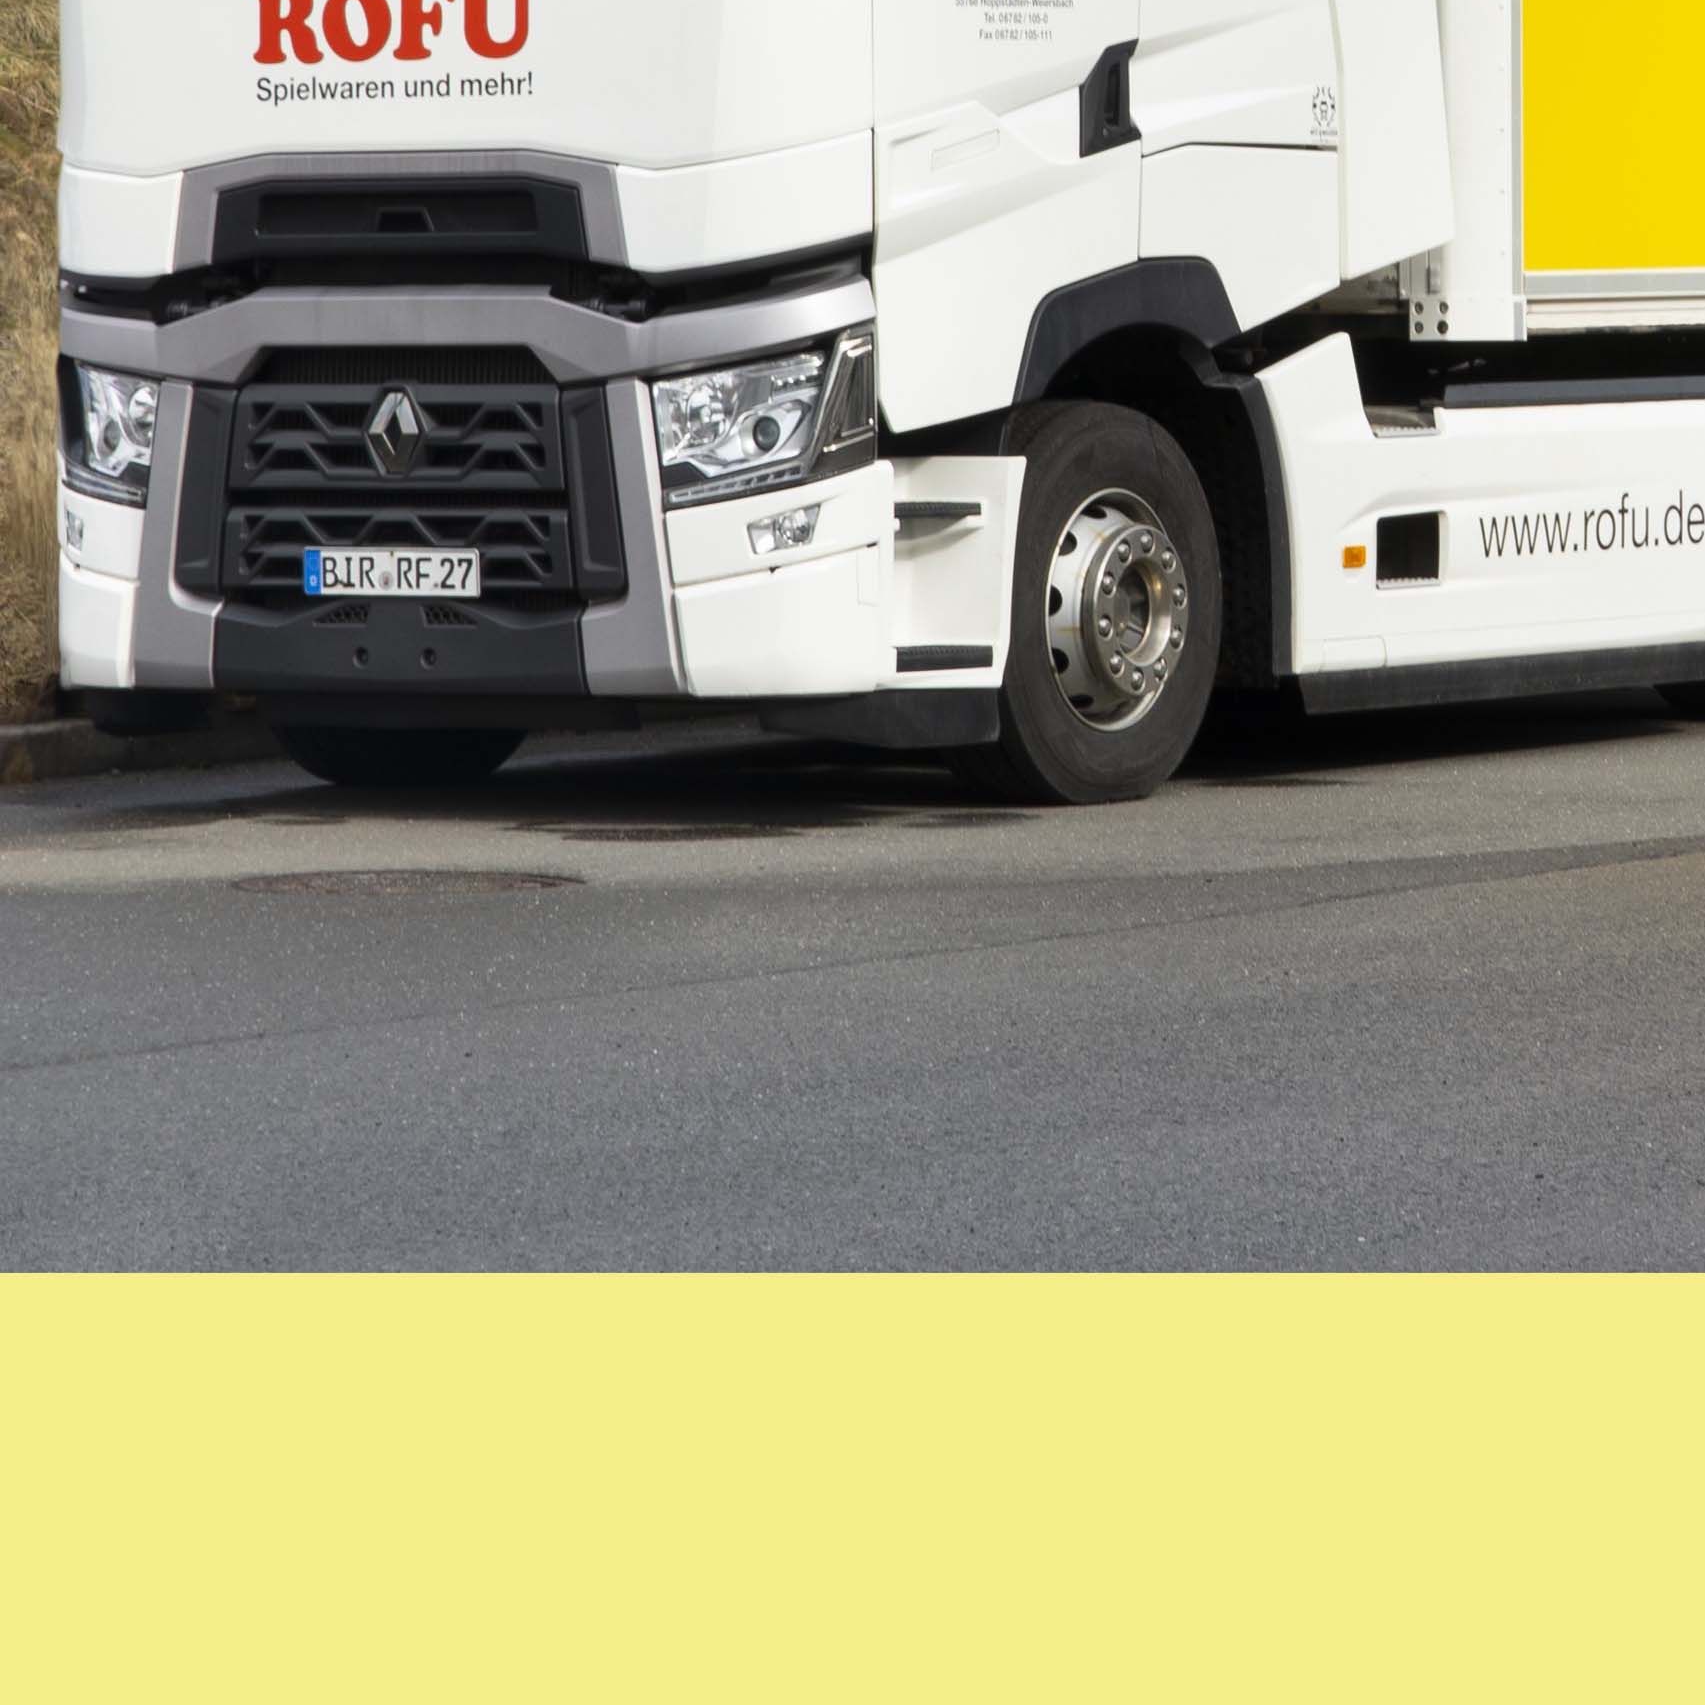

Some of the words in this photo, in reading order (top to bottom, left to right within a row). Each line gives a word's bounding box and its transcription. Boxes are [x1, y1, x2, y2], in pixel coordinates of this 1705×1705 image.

[256, 76, 395, 107] Spielwaren
[404, 72, 451, 99] und
[460, 70, 534, 97] mehr!
[1479, 490, 1705, 558] www.rofu.de
[322, 556, 375, 589] BIR
